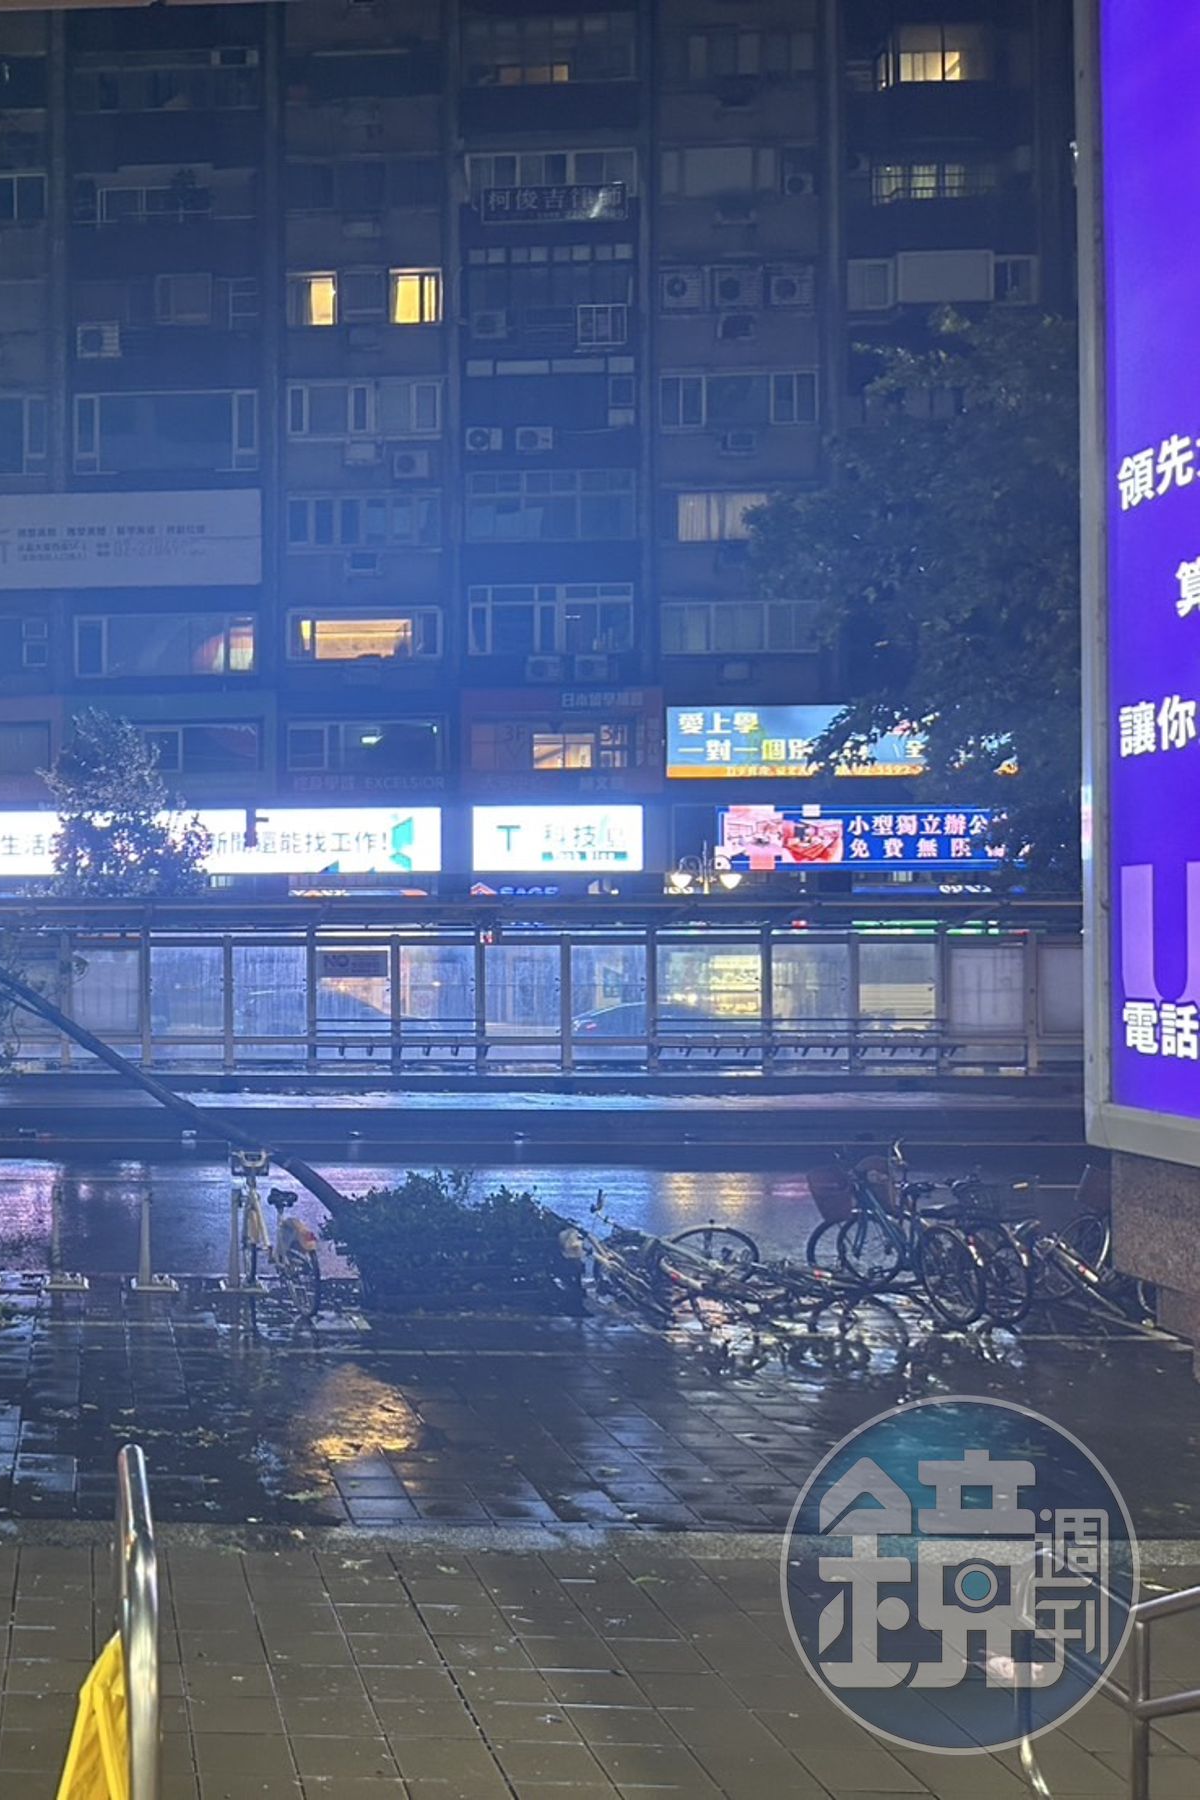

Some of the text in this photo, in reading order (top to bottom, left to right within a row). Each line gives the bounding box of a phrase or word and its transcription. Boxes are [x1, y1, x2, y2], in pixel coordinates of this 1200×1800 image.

[1117, 434, 1200, 511] 領先
[678, 712, 758, 734] 愛上學
[1119, 695, 1197, 758] 讓你
[367, 777, 445, 789] EXCELSIOR
[849, 814, 1007, 836] 小型獨立辦公
[1123, 1001, 1199, 1059] 電話
